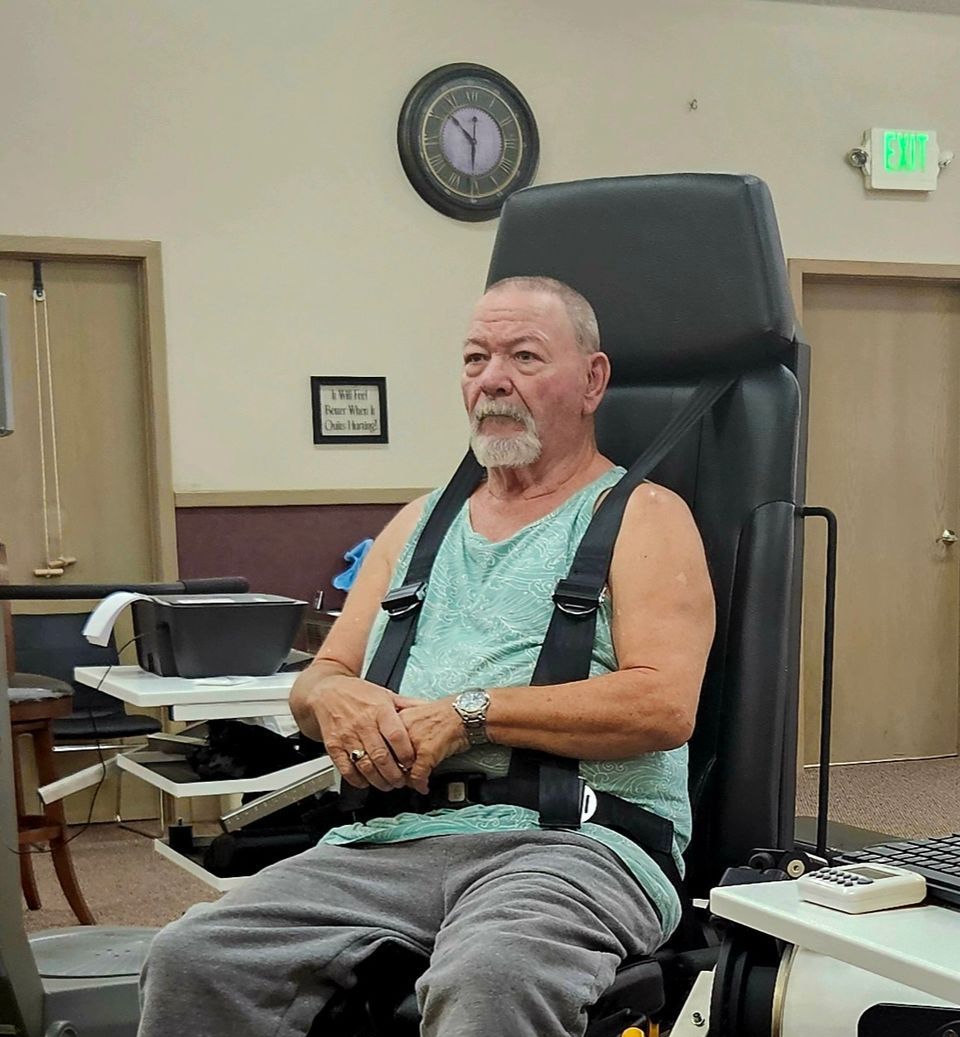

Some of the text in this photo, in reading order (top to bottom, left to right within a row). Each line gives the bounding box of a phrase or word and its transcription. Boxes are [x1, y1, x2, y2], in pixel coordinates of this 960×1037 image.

[884, 131, 929, 172] EXIT
[338, 389, 353, 401] Will
[353, 390, 368, 401] Feel
[324, 404, 346, 416] Better
[348, 405, 369, 416] When
[324, 419, 346, 432] Quits
